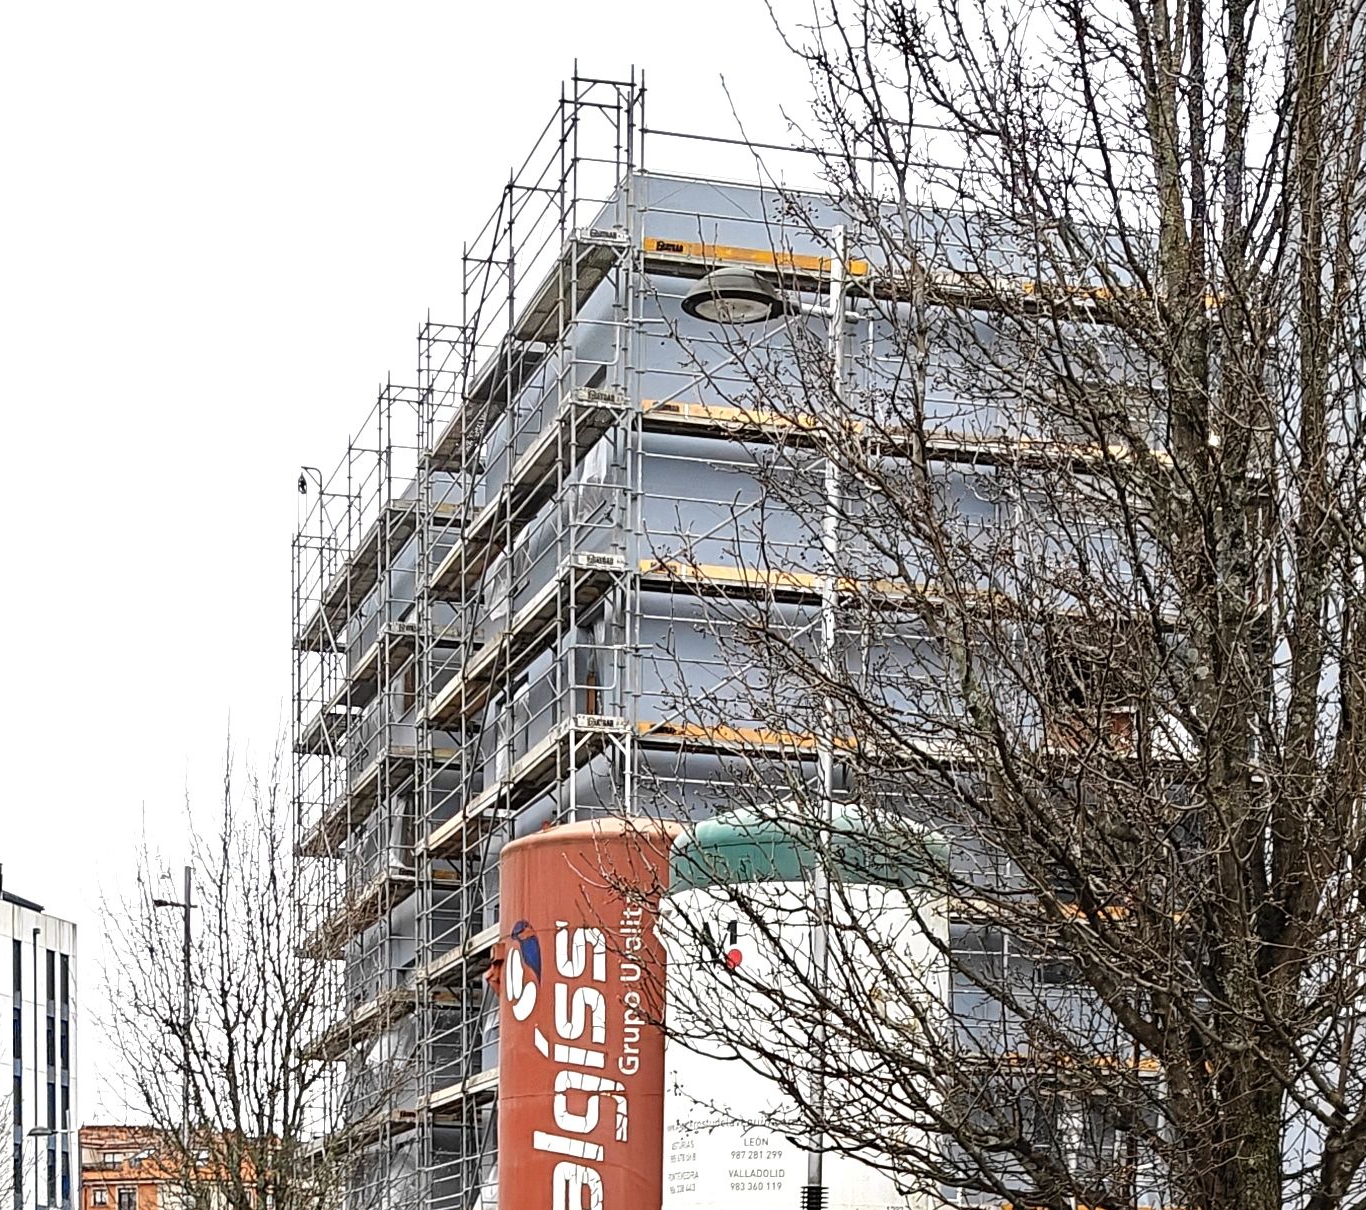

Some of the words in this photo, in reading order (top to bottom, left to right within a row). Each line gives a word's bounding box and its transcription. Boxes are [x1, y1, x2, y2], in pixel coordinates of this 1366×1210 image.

[618, 991, 646, 1075] Grupo
[744, 1137, 769, 1147] LEÓN
[731, 1151, 745, 1159] 987
[748, 1151, 763, 1159] 281
[766, 1151, 783, 1160] 299
[728, 1169, 785, 1178] VALLADOLID
[730, 1182, 745, 1191] 983
[747, 1182, 763, 1191] 360
[767, 1182, 782, 1190] 119
